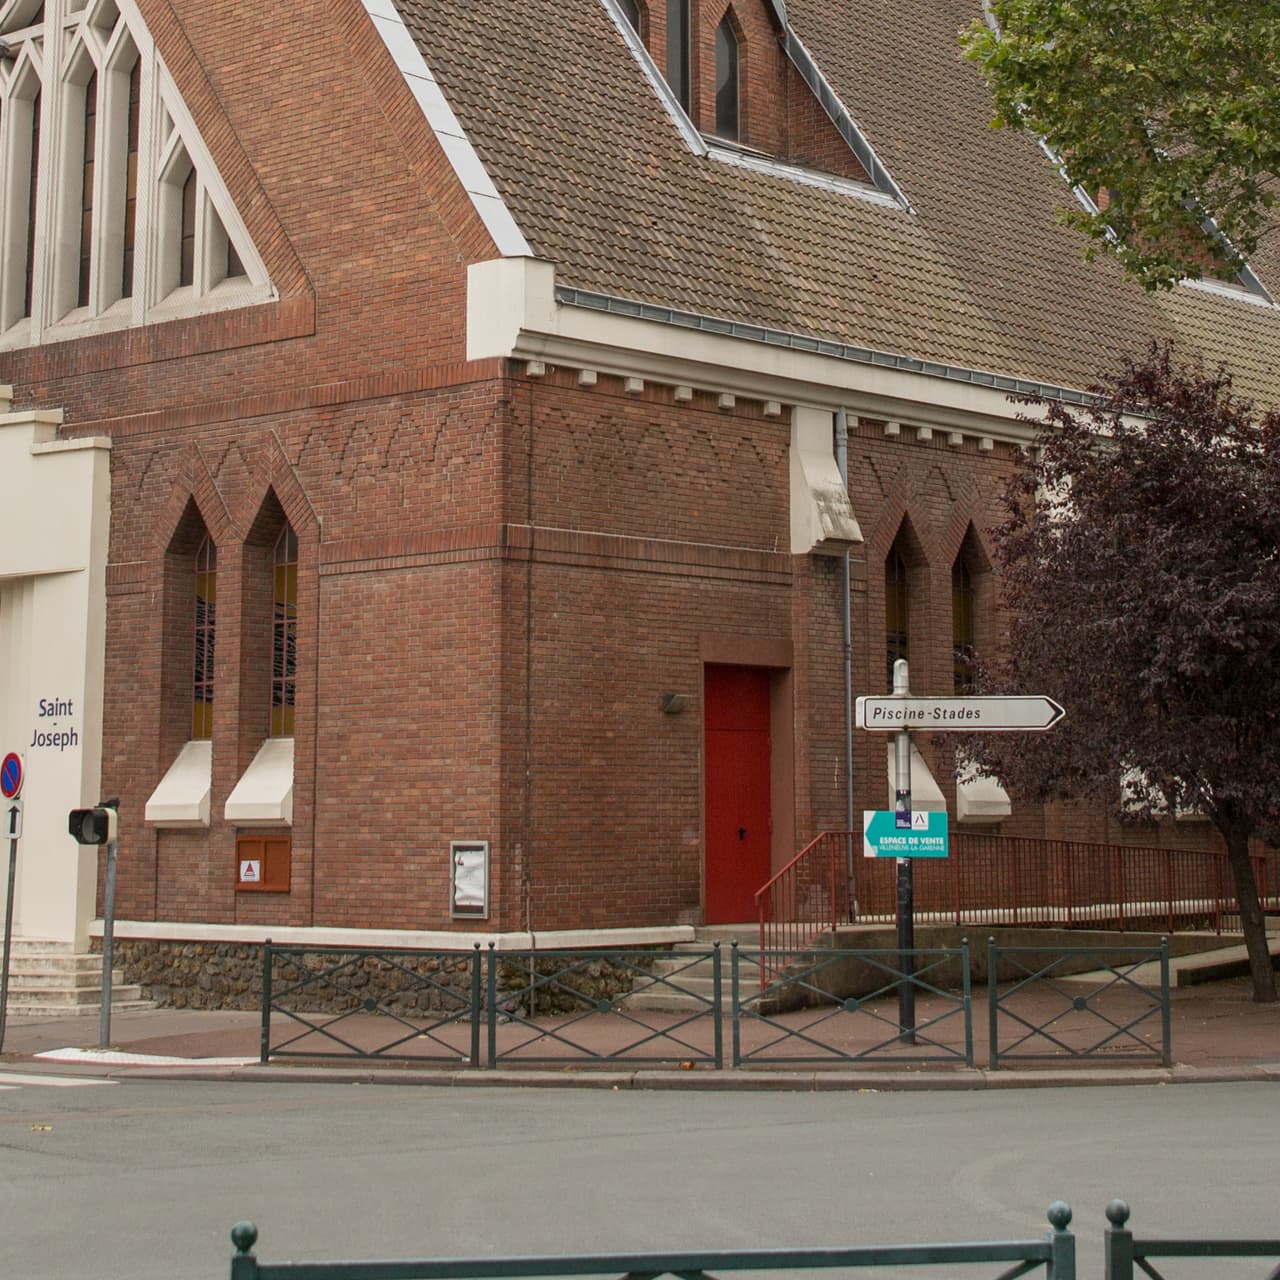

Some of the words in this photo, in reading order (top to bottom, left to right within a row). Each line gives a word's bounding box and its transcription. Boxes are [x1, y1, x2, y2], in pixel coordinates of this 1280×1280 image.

[38, 696, 73, 717] Saint
[873, 706, 981, 720] Piscine-Stades
[30, 727, 78, 752] Joseph
[879, 836, 907, 844] ESPACE
[908, 836, 919, 844] DE
[919, 836, 944, 844] VENTE
